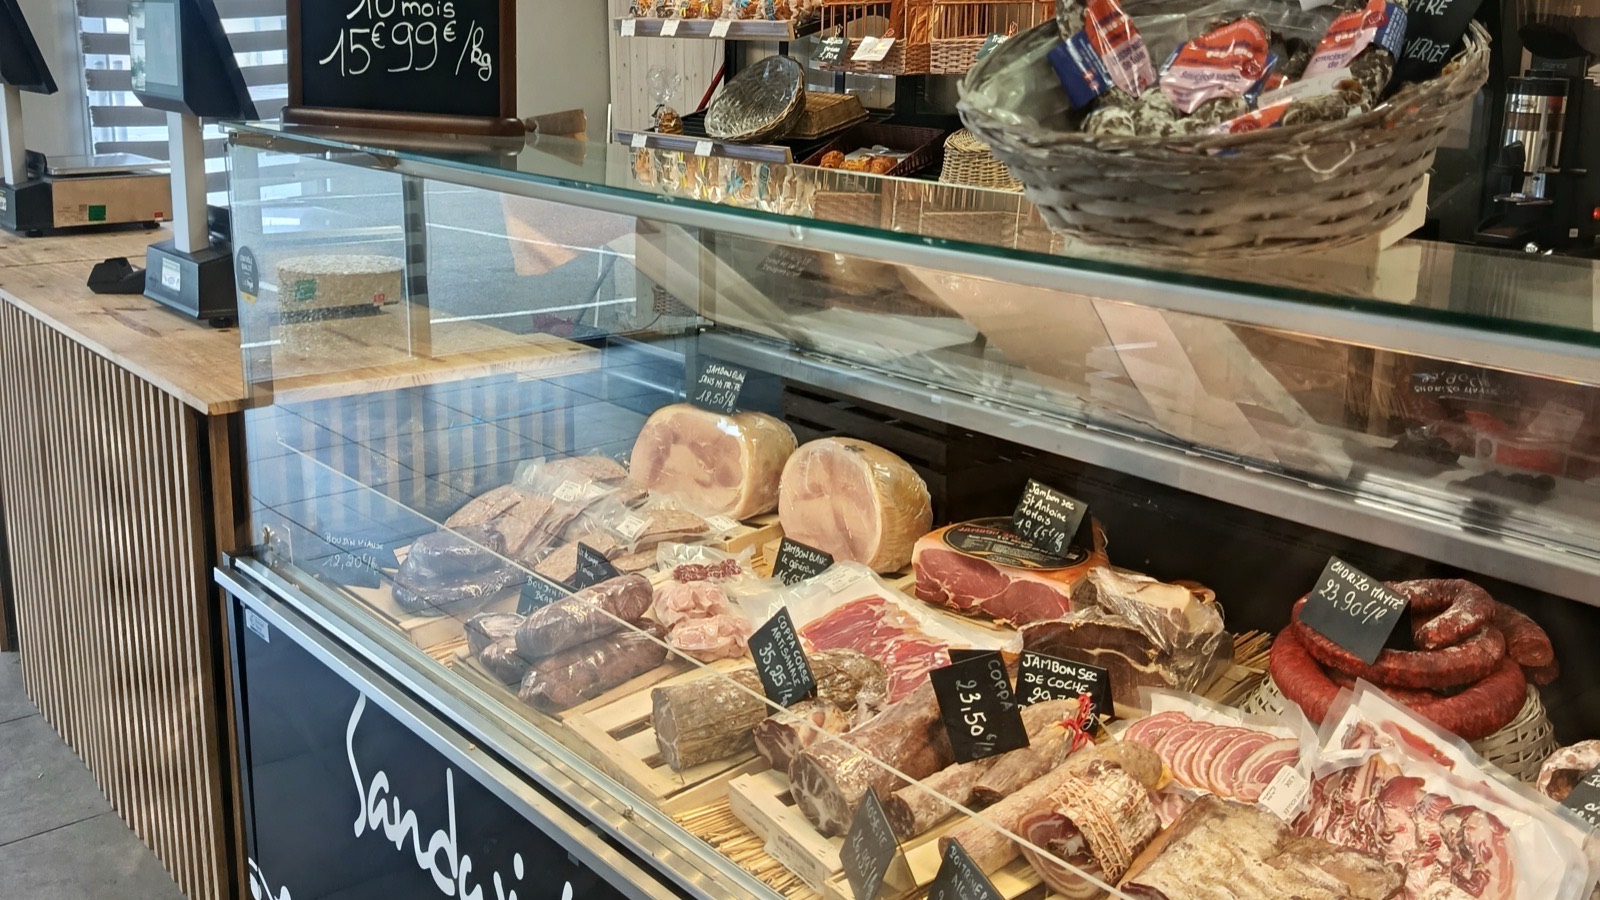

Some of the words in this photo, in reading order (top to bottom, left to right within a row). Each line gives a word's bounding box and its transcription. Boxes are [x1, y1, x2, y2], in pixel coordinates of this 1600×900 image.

[401, 1, 456, 18] mois
[1022, 493, 1036, 507] St
[1034, 499, 1067, 523] Antoine
[1028, 482, 1060, 505] Jambon
[1060, 498, 1075, 511] sec
[782, 541, 810, 560] JAMBON
[770, 626, 801, 688] ARTISANALE
[777, 614, 797, 650] COPPA
[793, 649, 811, 686] CORSE
[1022, 653, 1076, 677] JAMBON
[1077, 667, 1098, 683] SEC
[987, 658, 1015, 713] COPPA
[1024, 672, 1045, 686] DE
[1047, 676, 1090, 695] COCHE
